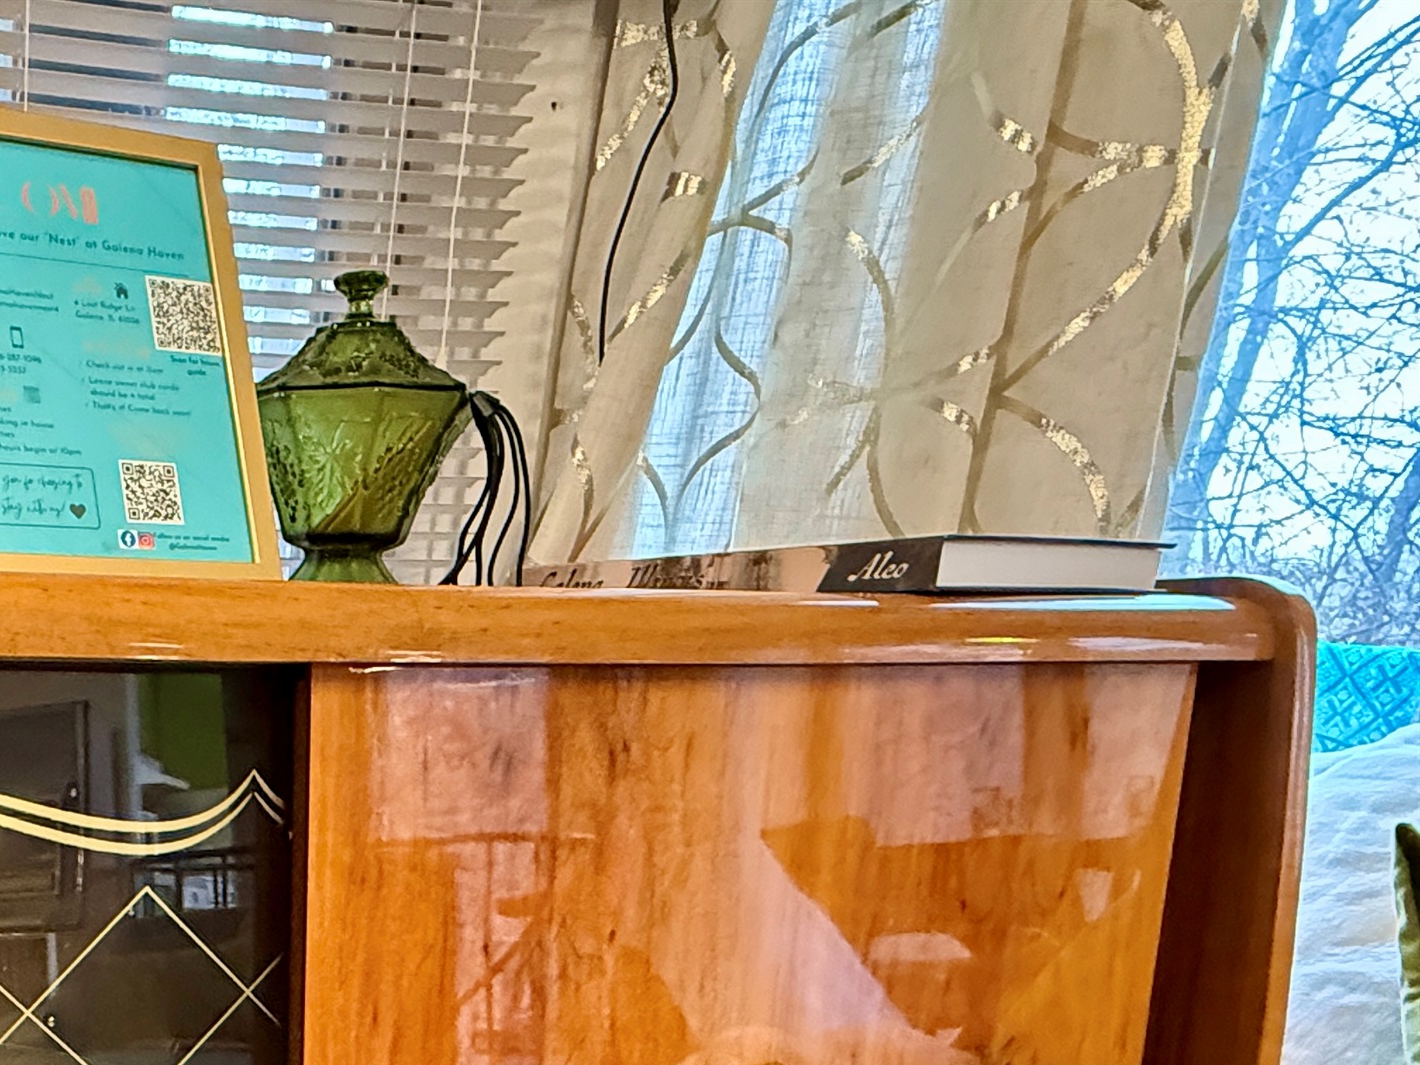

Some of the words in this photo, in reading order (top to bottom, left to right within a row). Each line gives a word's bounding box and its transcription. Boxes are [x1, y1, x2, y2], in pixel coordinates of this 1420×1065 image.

[20, 232, 40, 242] our
[85, 240, 98, 249] at
[147, 247, 185, 261] Haven
